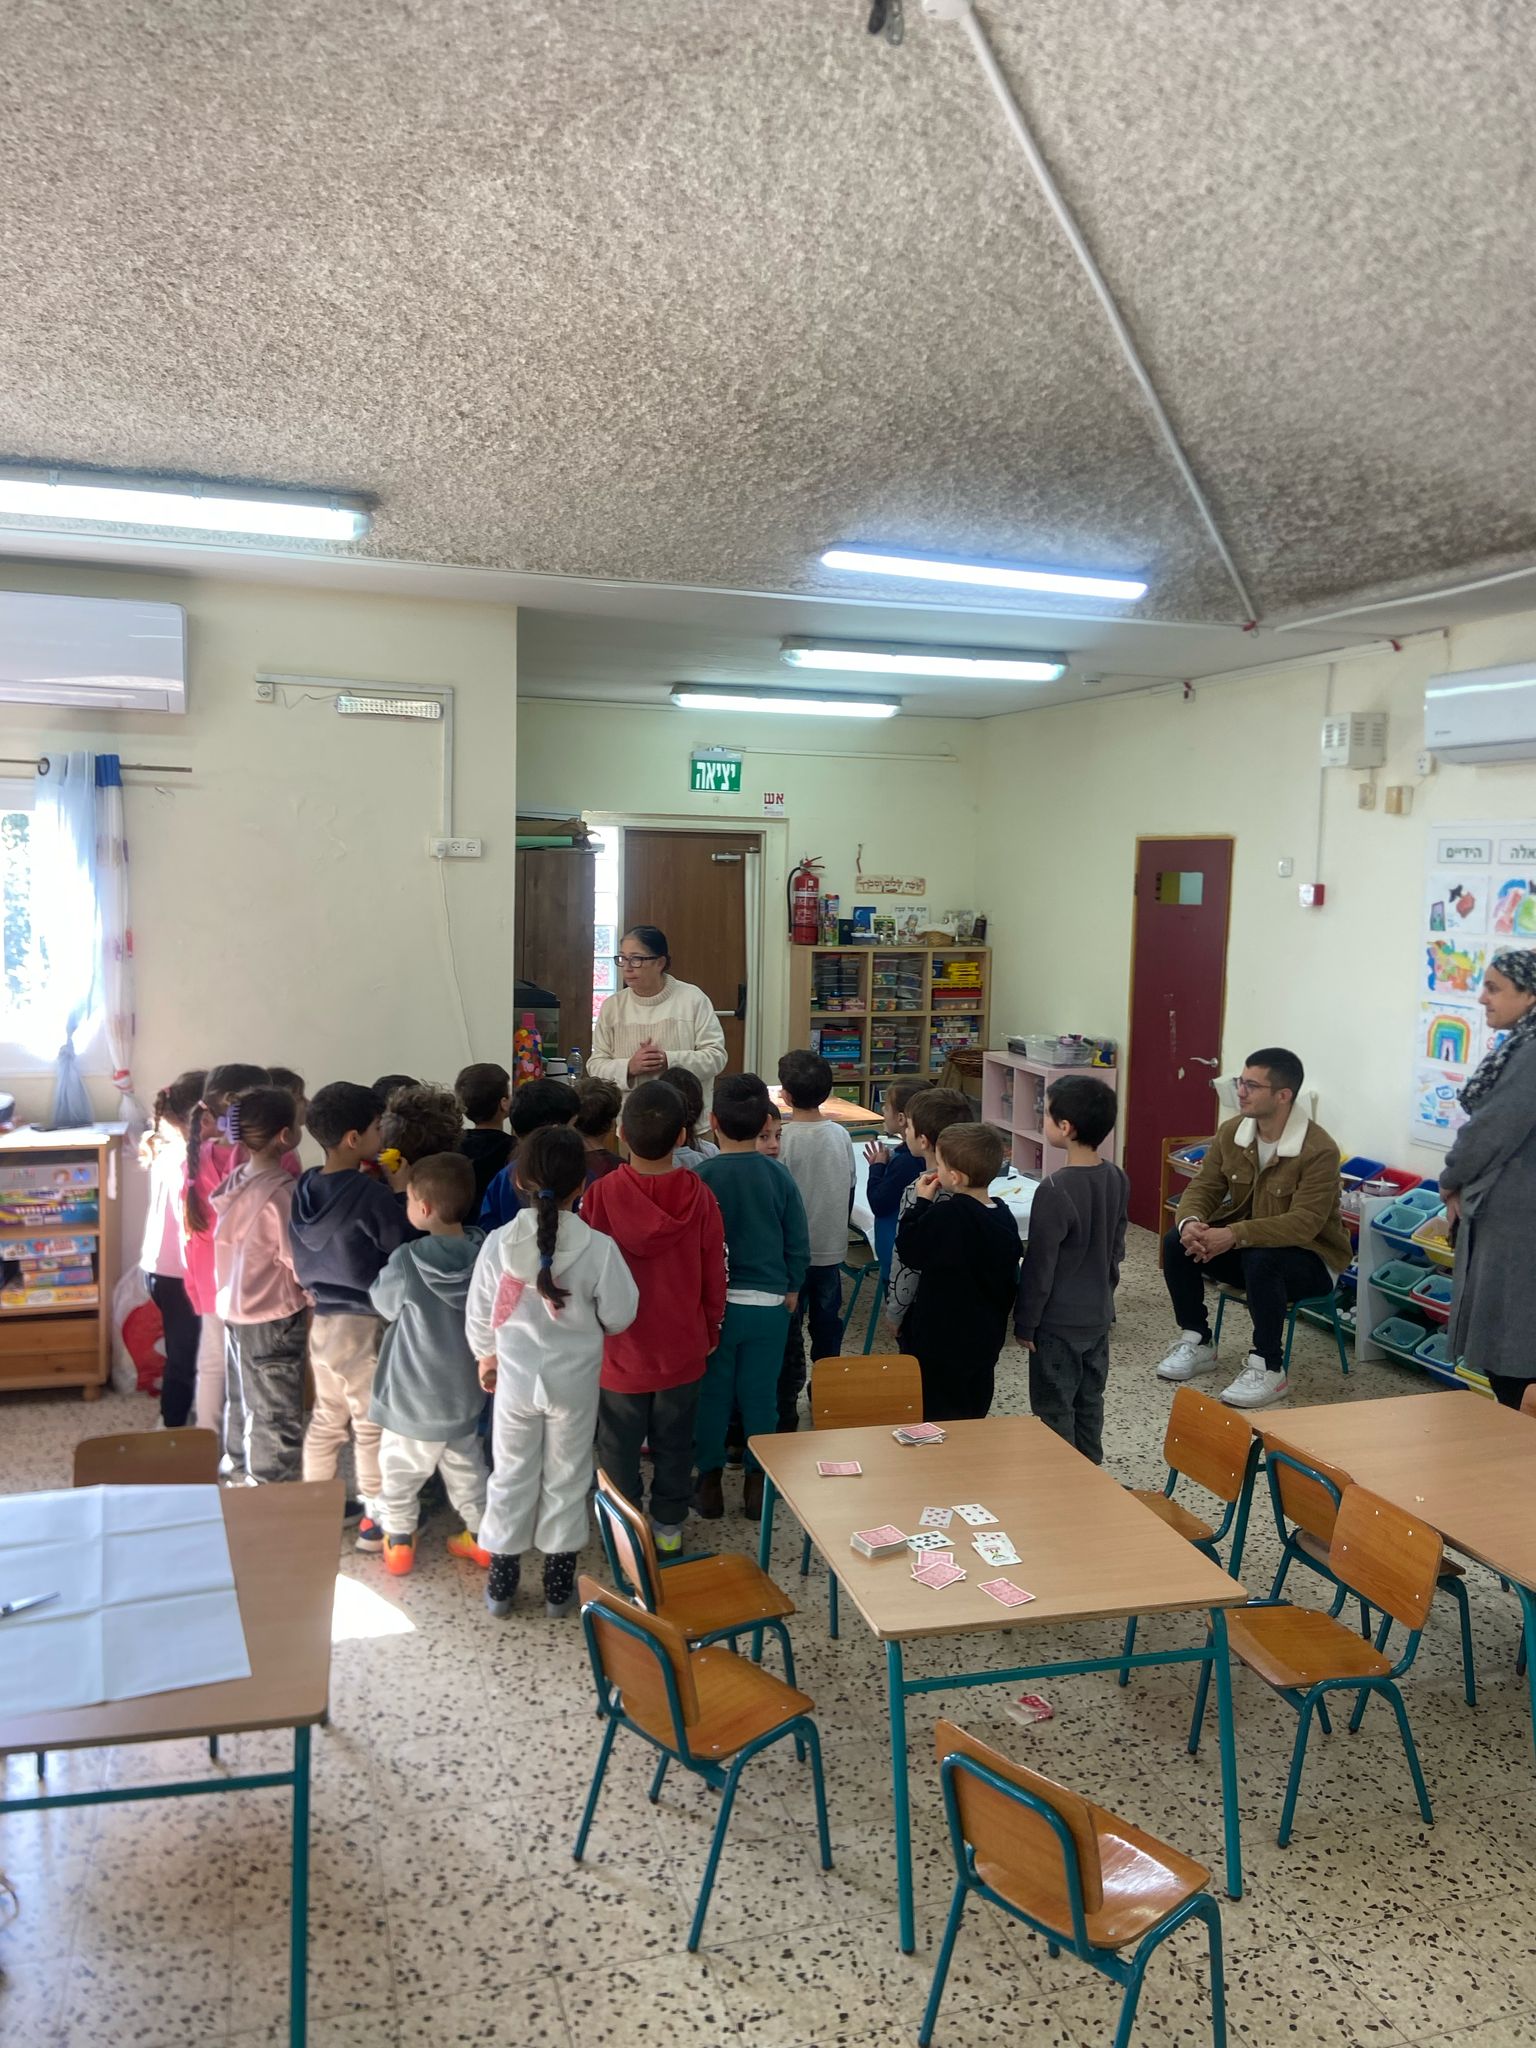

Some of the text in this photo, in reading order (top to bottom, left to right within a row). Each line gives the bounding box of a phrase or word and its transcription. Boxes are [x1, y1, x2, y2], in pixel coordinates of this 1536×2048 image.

[695, 761, 737, 790] יציאה
[763, 792, 785, 805] אש
[1446, 847, 1482, 858] הידיים
